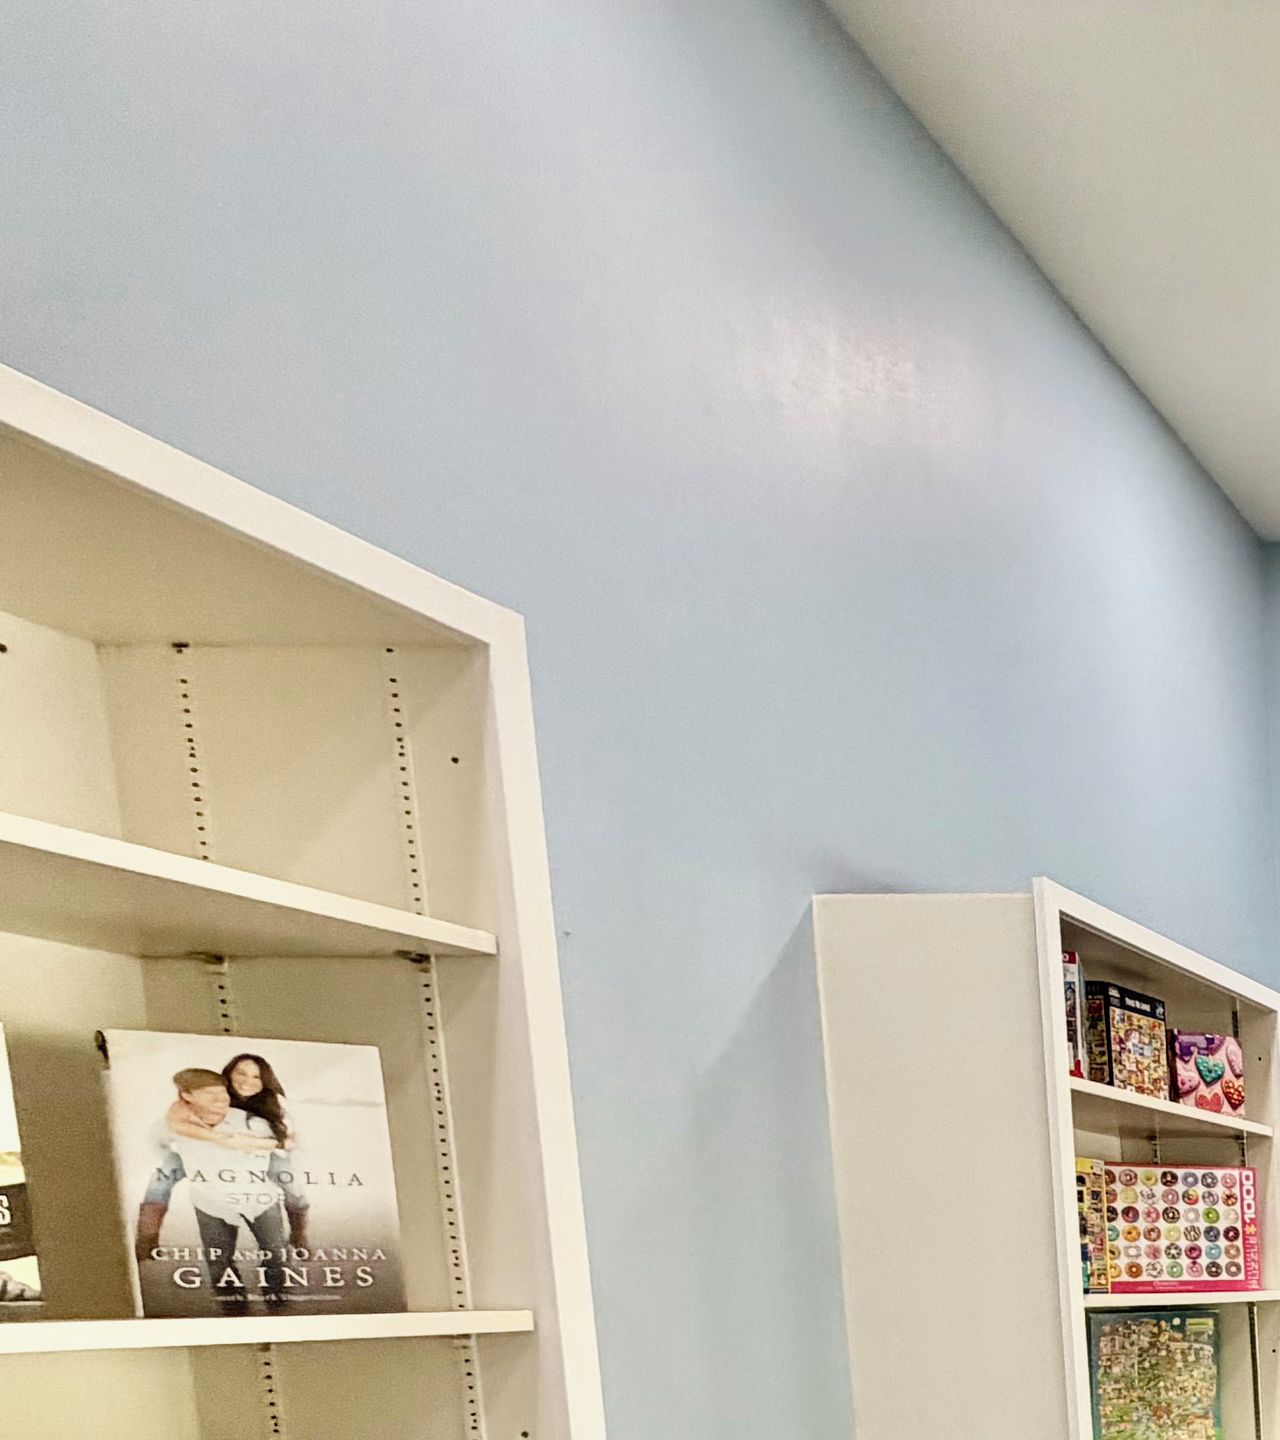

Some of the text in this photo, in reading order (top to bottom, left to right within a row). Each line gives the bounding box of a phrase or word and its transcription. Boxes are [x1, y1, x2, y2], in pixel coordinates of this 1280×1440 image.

[155, 1167, 365, 1186] MAGNOLIA
[1241, 1169, 1257, 1223] 1000
[151, 1246, 386, 1262] CHIP AND JOANNA
[173, 1266, 374, 1288] GAINES
